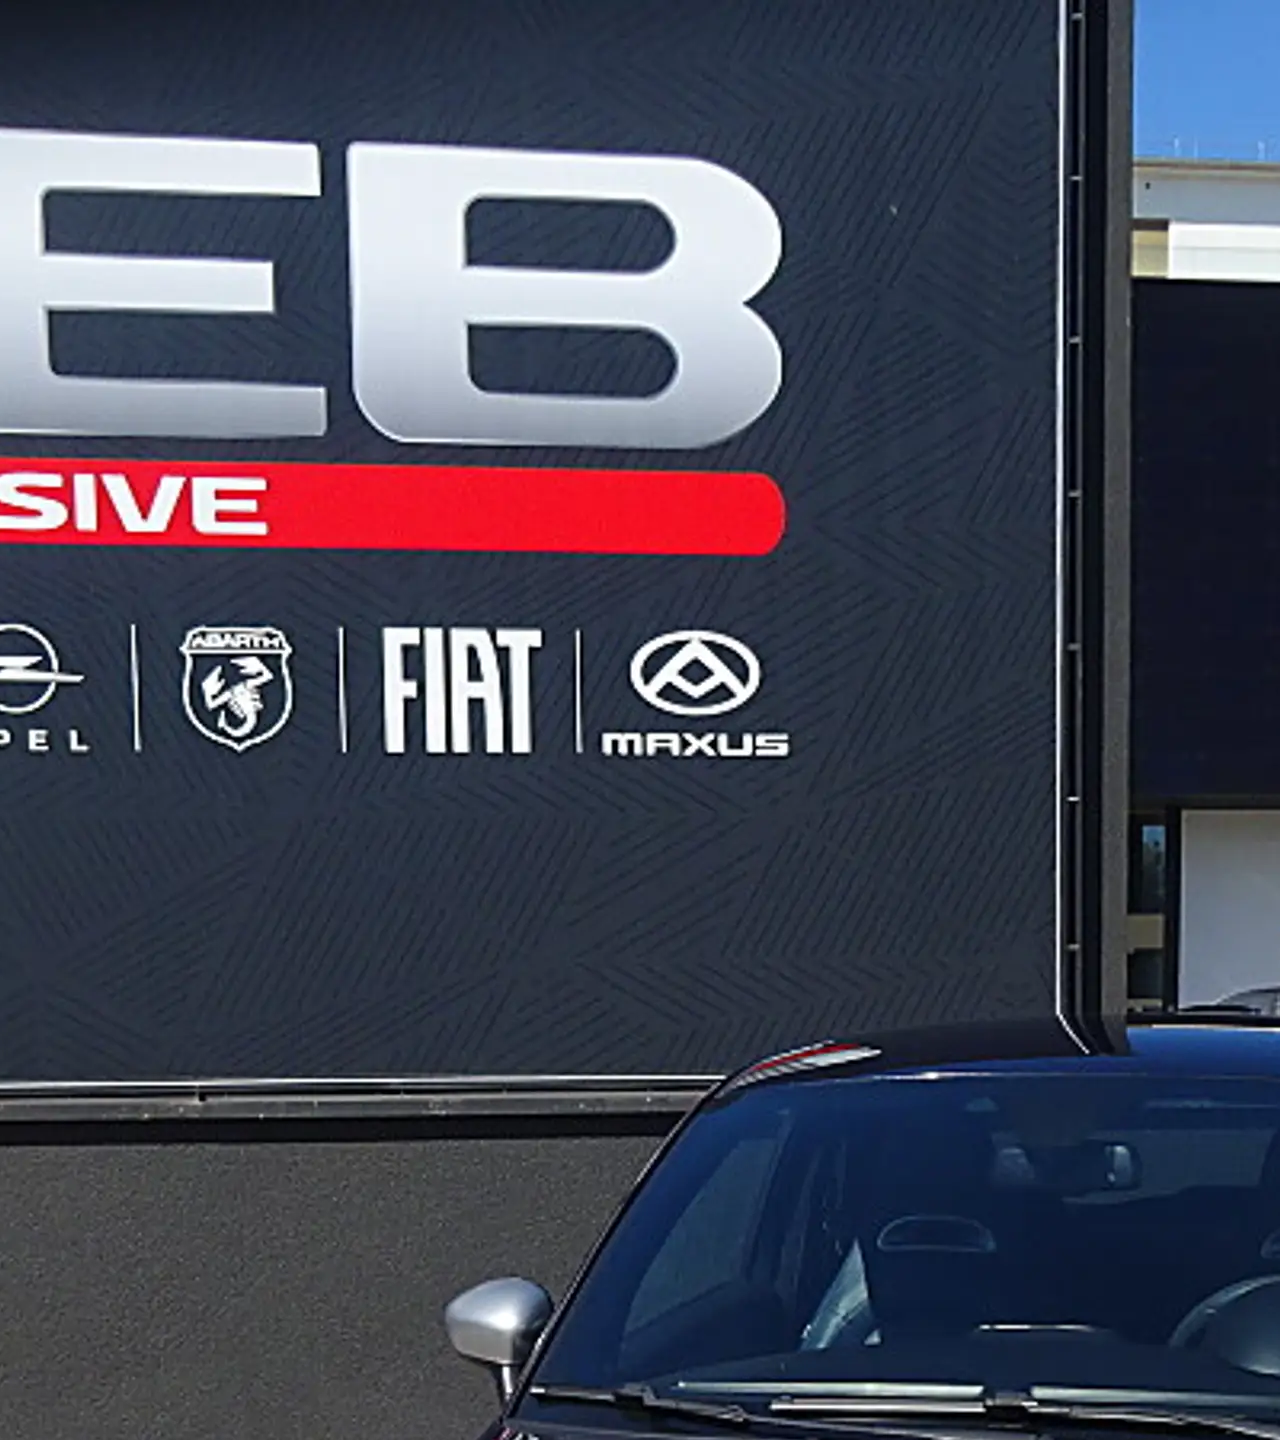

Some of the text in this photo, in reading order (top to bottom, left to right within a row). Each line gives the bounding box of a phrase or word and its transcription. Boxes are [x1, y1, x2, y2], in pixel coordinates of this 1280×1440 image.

[191, 632, 281, 650] ABARTH
[381, 626, 543, 755] FIAT
[601, 731, 790, 758] MAXUS
